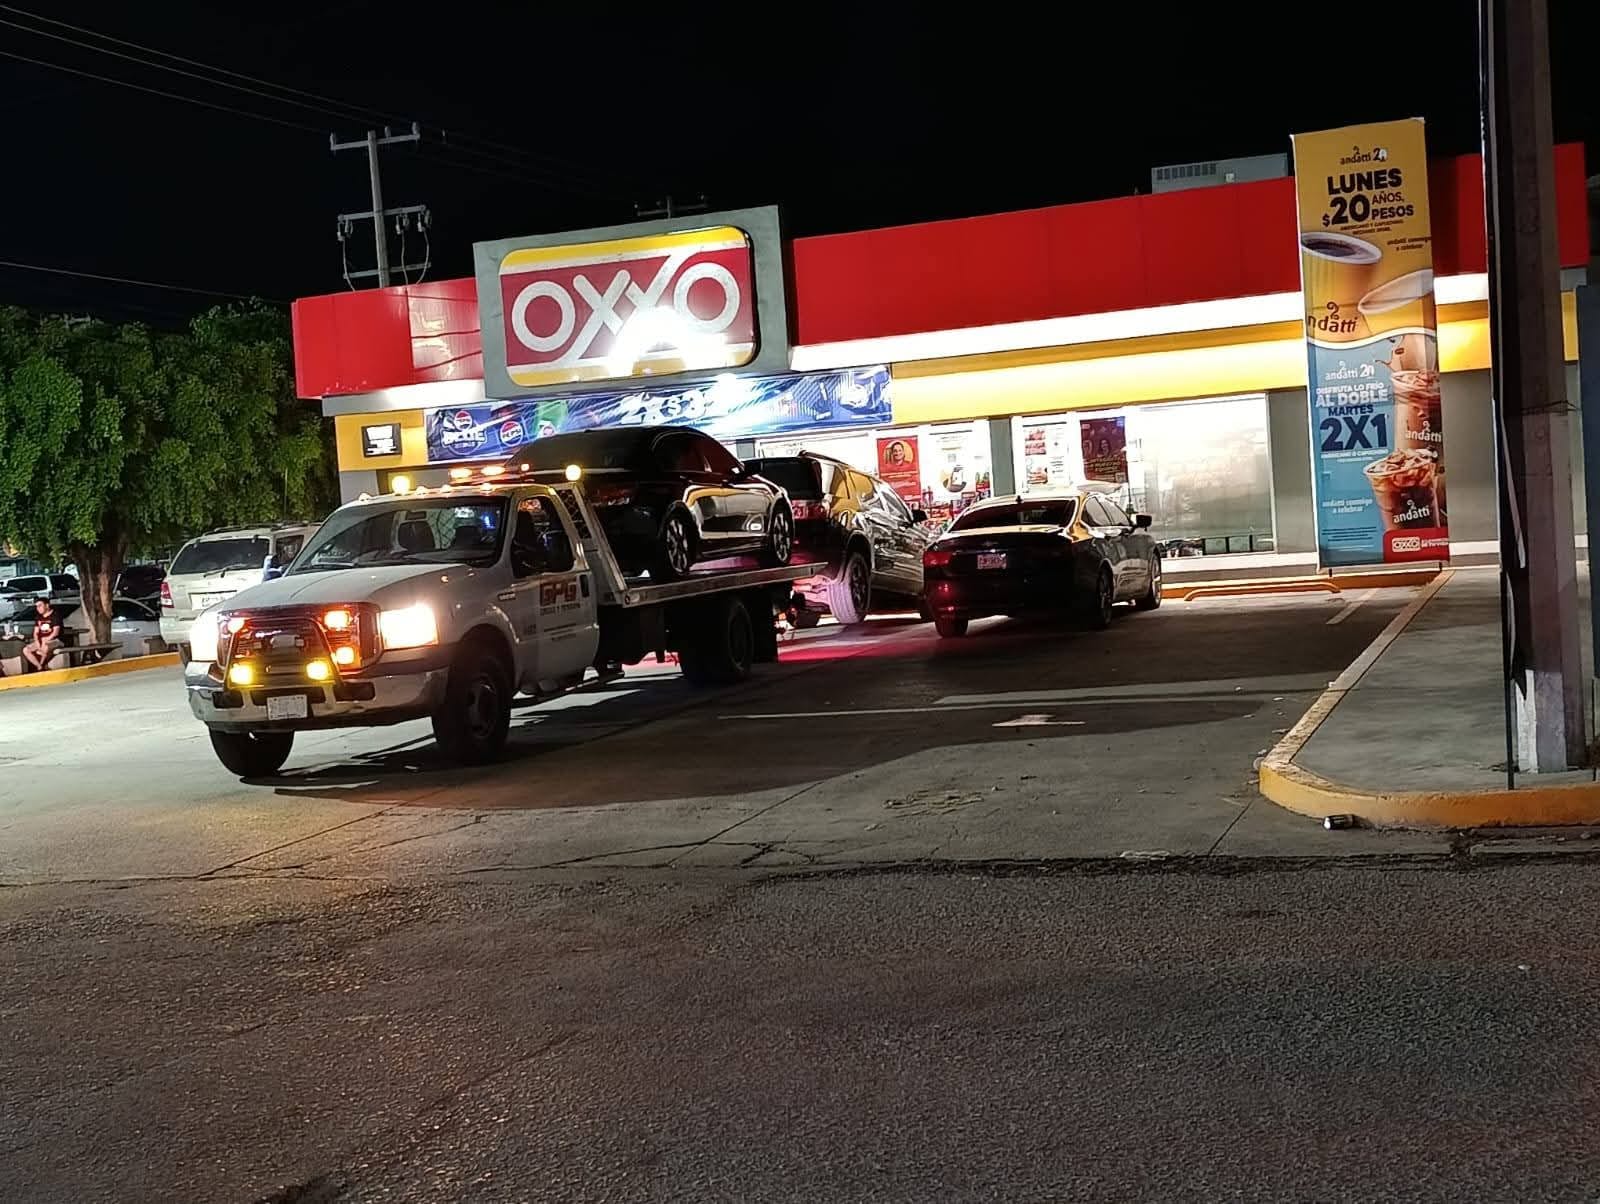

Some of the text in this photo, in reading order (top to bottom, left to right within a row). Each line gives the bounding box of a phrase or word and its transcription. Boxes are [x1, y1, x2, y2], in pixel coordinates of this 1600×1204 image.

[1327, 168, 1402, 195] LUNES
[1371, 205, 1414, 220] PESOS
[512, 253, 740, 361] OXXO
[1307, 303, 1358, 333] ndatti
[1325, 361, 1358, 380] andatti
[1315, 389, 1388, 407] AL DOBLE
[1328, 405, 1374, 416] MARTES
[1319, 413, 1388, 451] 2X1
[1393, 500, 1431, 524] andatti
